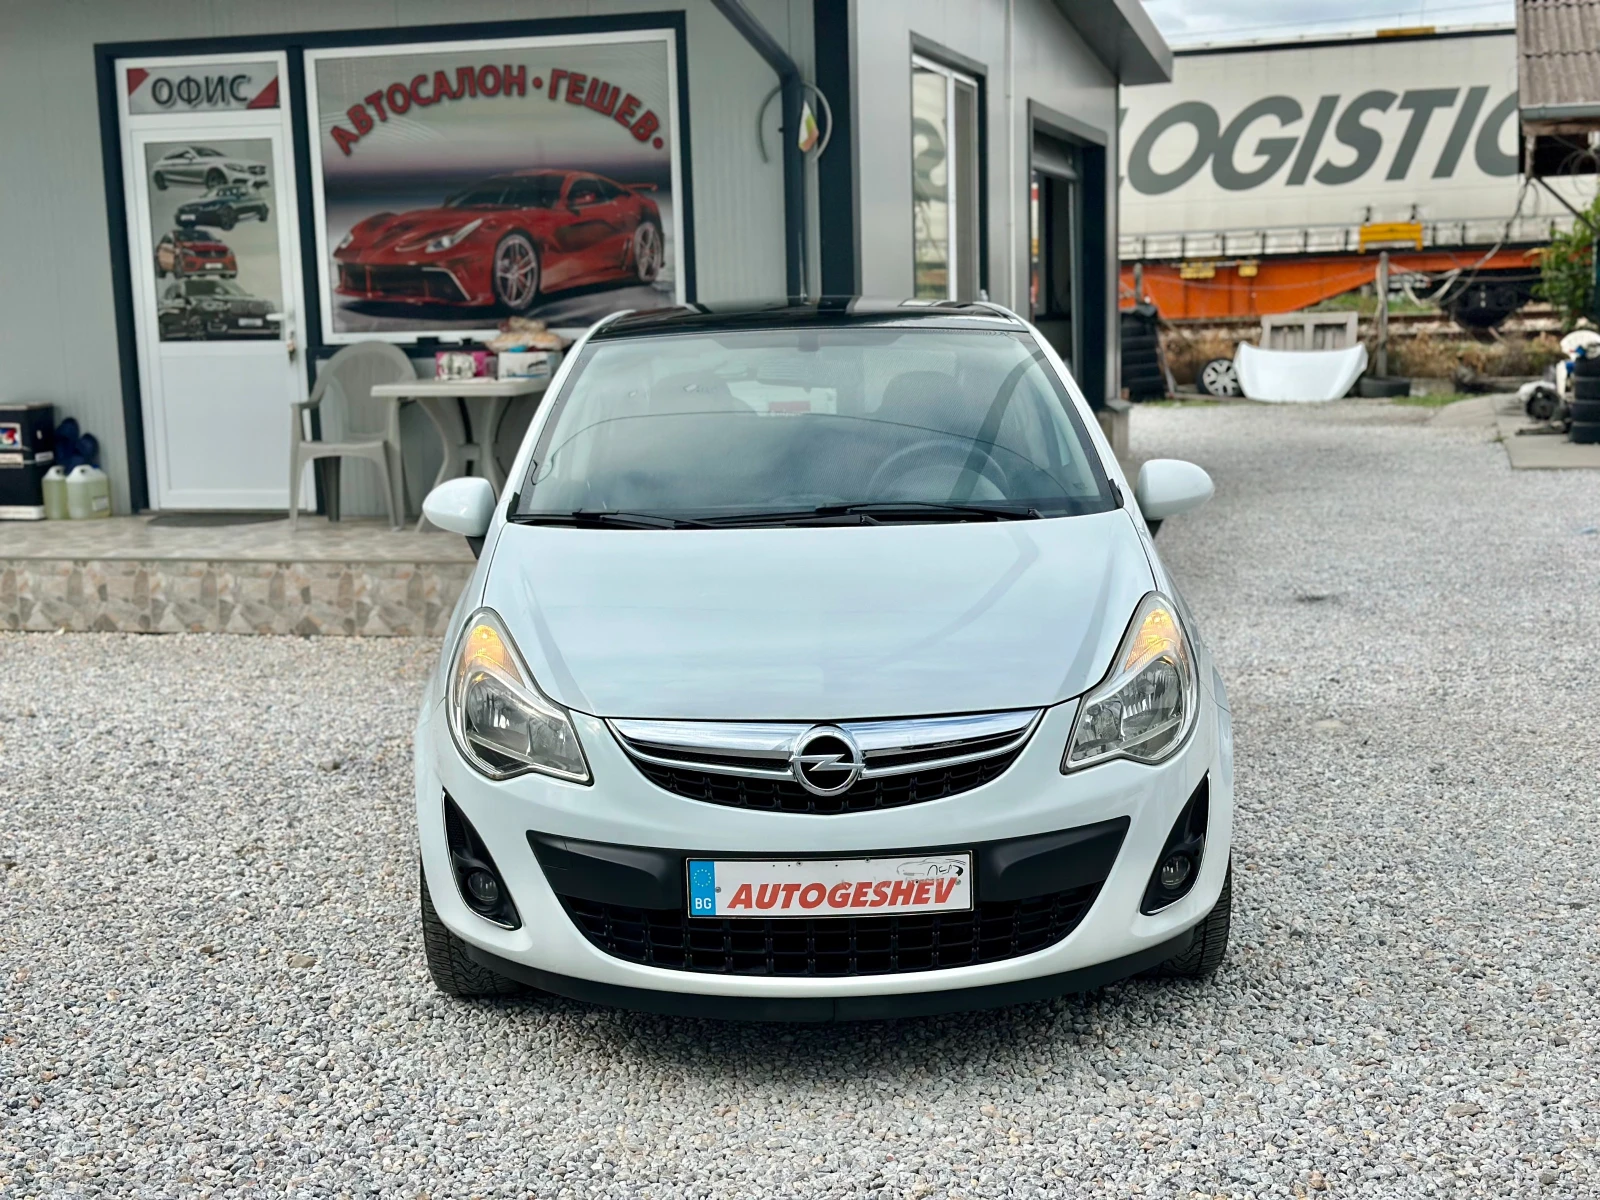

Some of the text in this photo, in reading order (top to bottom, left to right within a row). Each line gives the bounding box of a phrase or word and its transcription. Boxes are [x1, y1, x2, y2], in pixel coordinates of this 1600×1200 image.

[151, 75, 251, 107] ОФИС
[330, 64, 526, 157] АВТОСАЛОН
[1119, 85, 1519, 196] OGISTIC
[695, 898, 712, 910] BG
[727, 877, 957, 909] AUTOGESHEV
